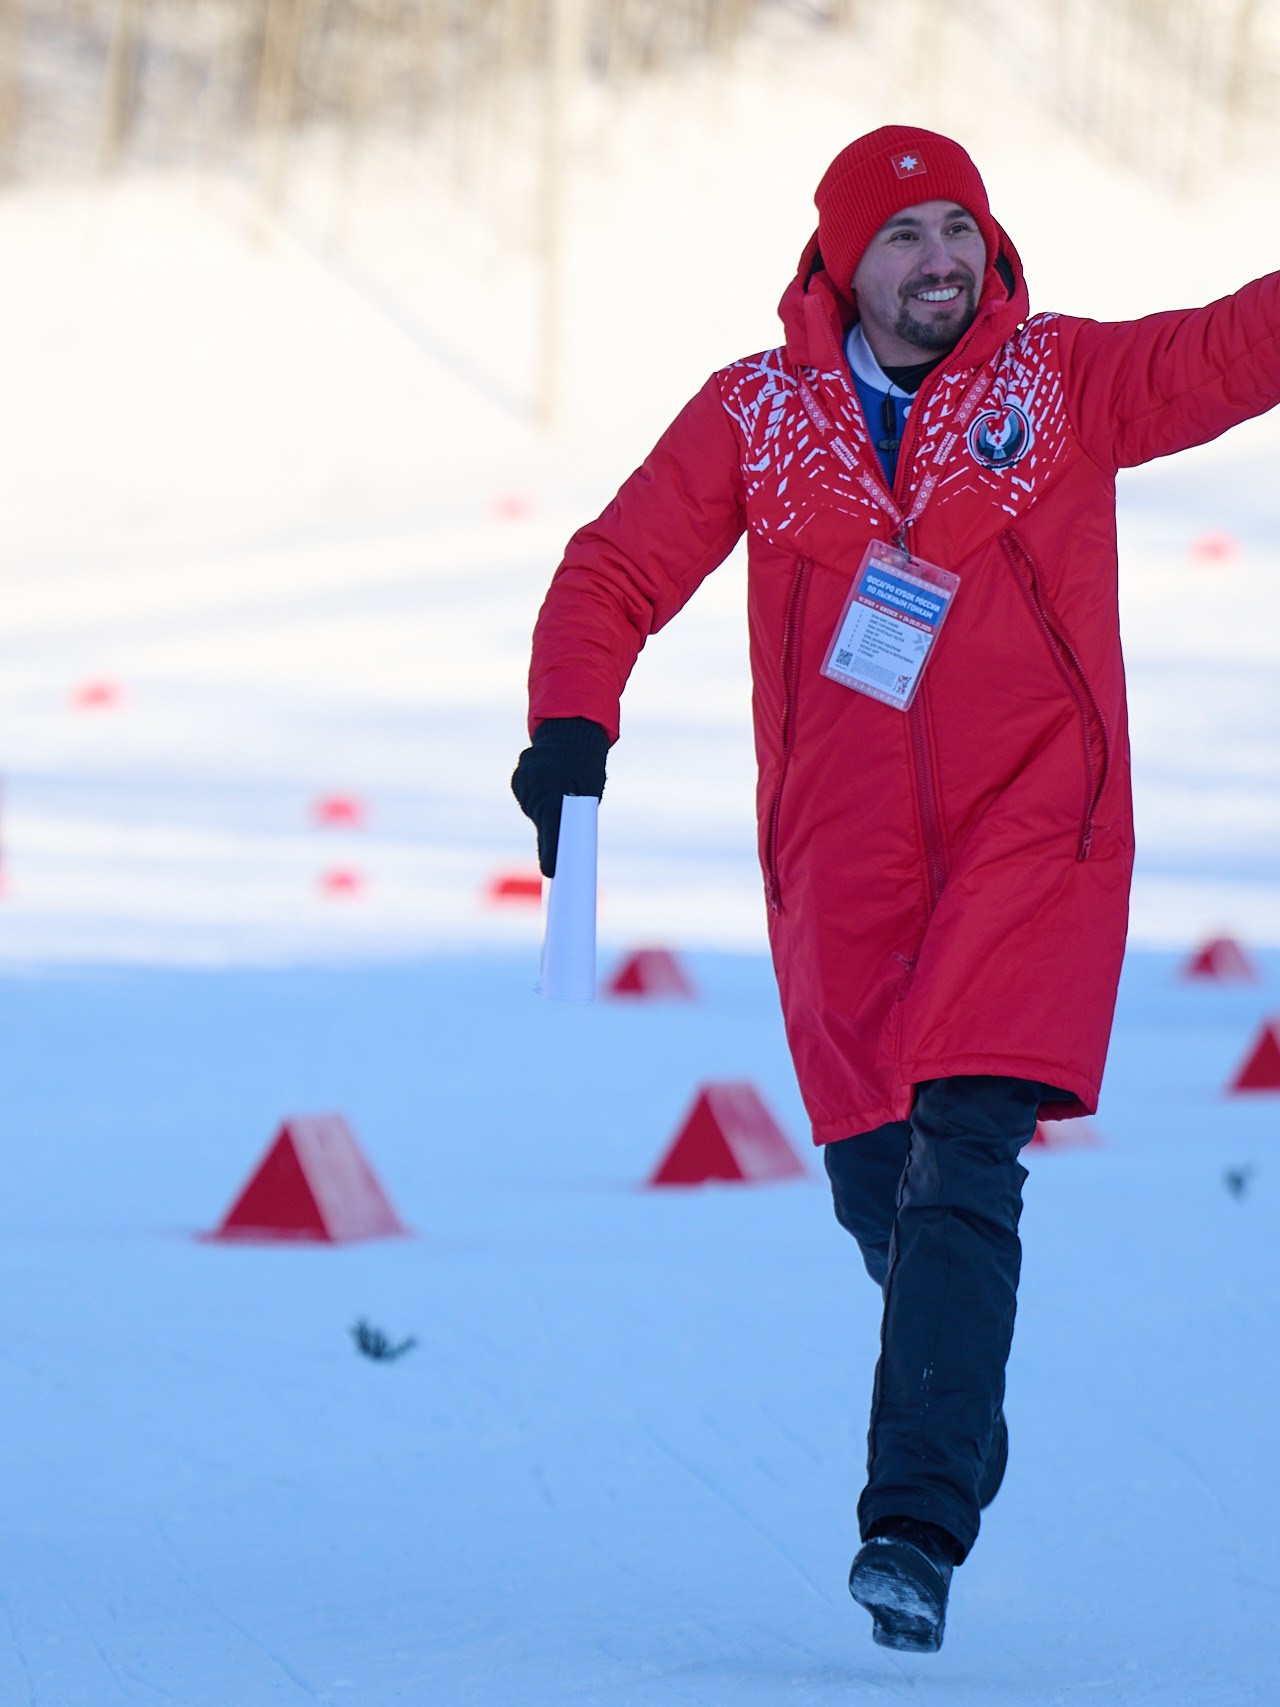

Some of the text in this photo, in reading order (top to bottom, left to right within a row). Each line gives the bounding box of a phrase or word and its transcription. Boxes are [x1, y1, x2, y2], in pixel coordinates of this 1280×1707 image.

[865, 574, 941, 613] ФОСАГРО КУБОК РОССИИ
[865, 584, 934, 620] ПО ЛЫЖНЫМ ГОНКАМ
